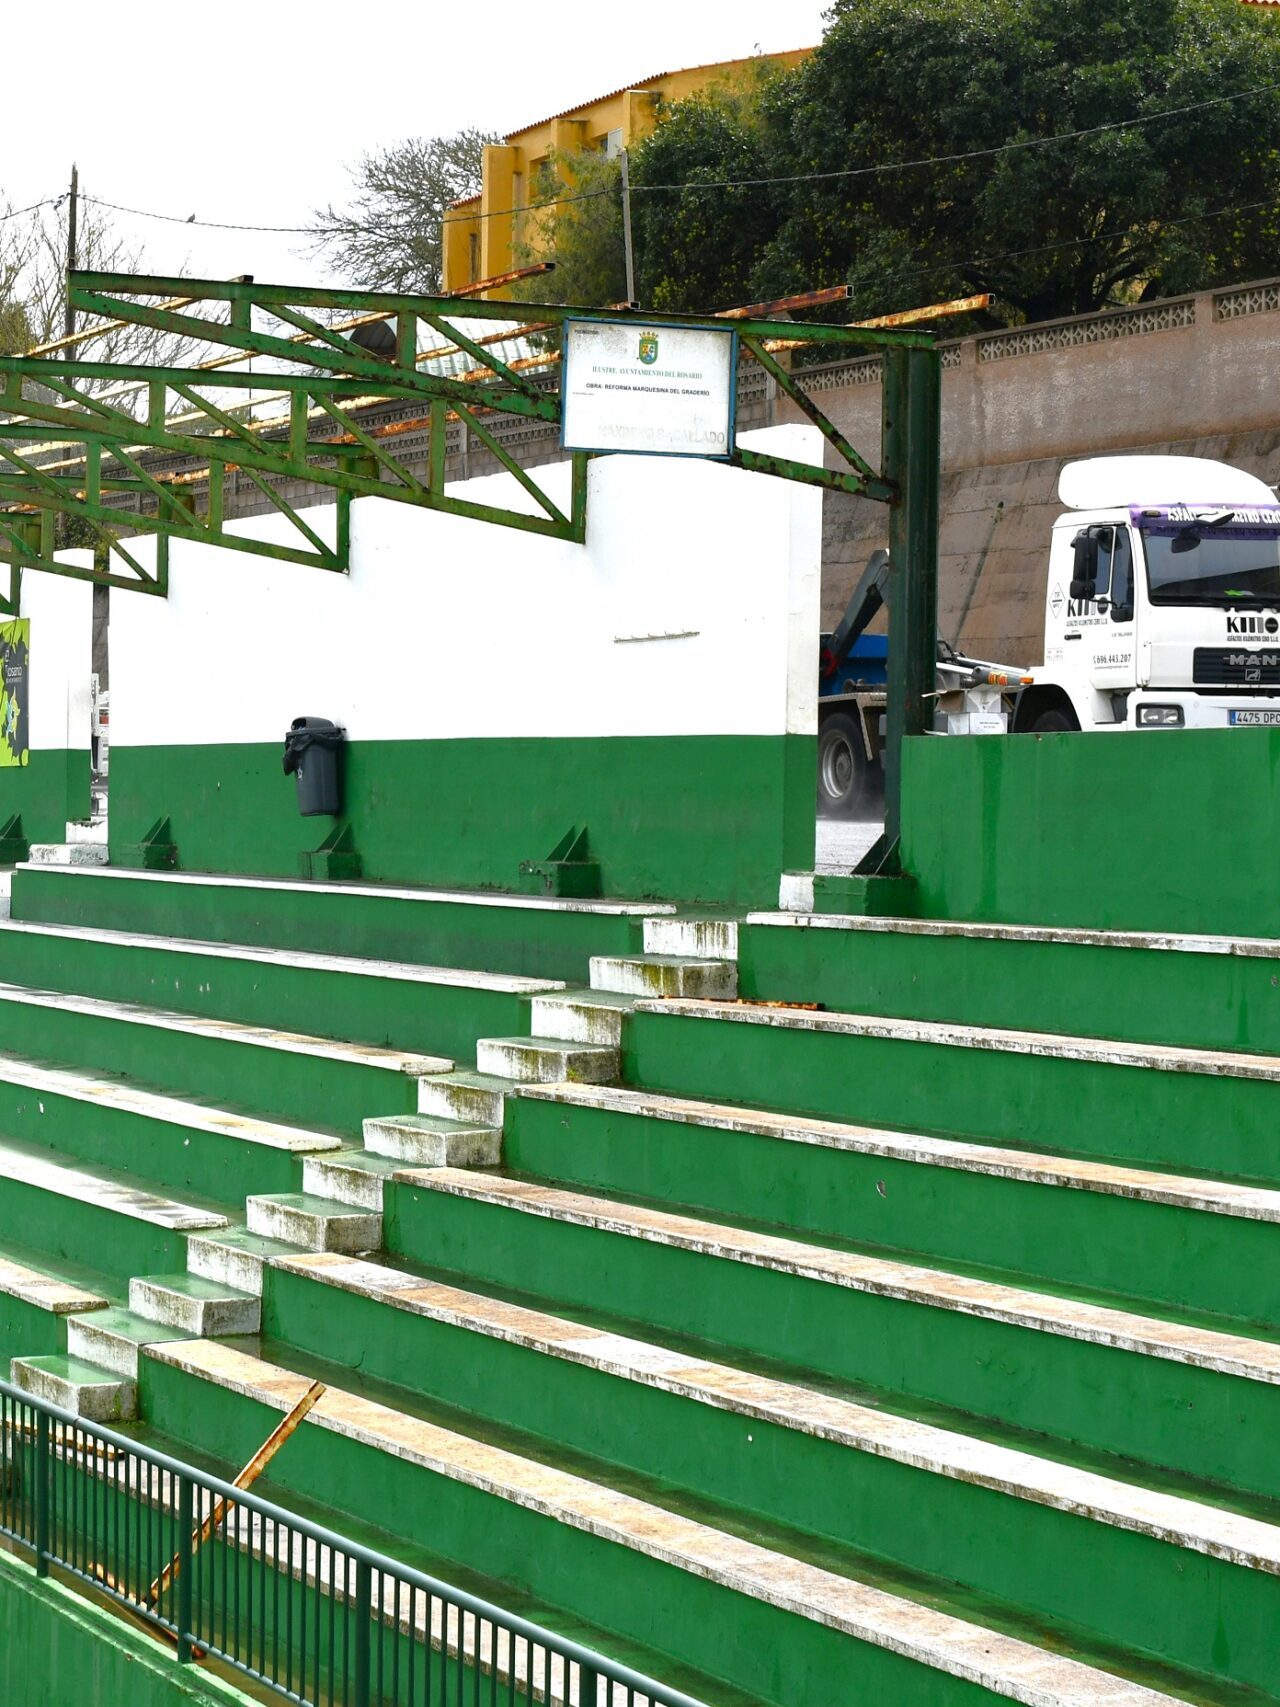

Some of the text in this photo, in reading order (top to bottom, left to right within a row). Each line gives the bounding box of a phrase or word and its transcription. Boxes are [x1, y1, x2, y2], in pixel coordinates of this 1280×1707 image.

[619, 368, 664, 378] AYUNTAMIENTO
[665, 370, 675, 379] DEL
[677, 371, 703, 380] ROSARIO
[605, 384, 632, 392] REFORMA
[632, 386, 669, 394] MARQUESINA
[1229, 654, 1277, 666] MAN
[1236, 712, 1261, 723] 4475
